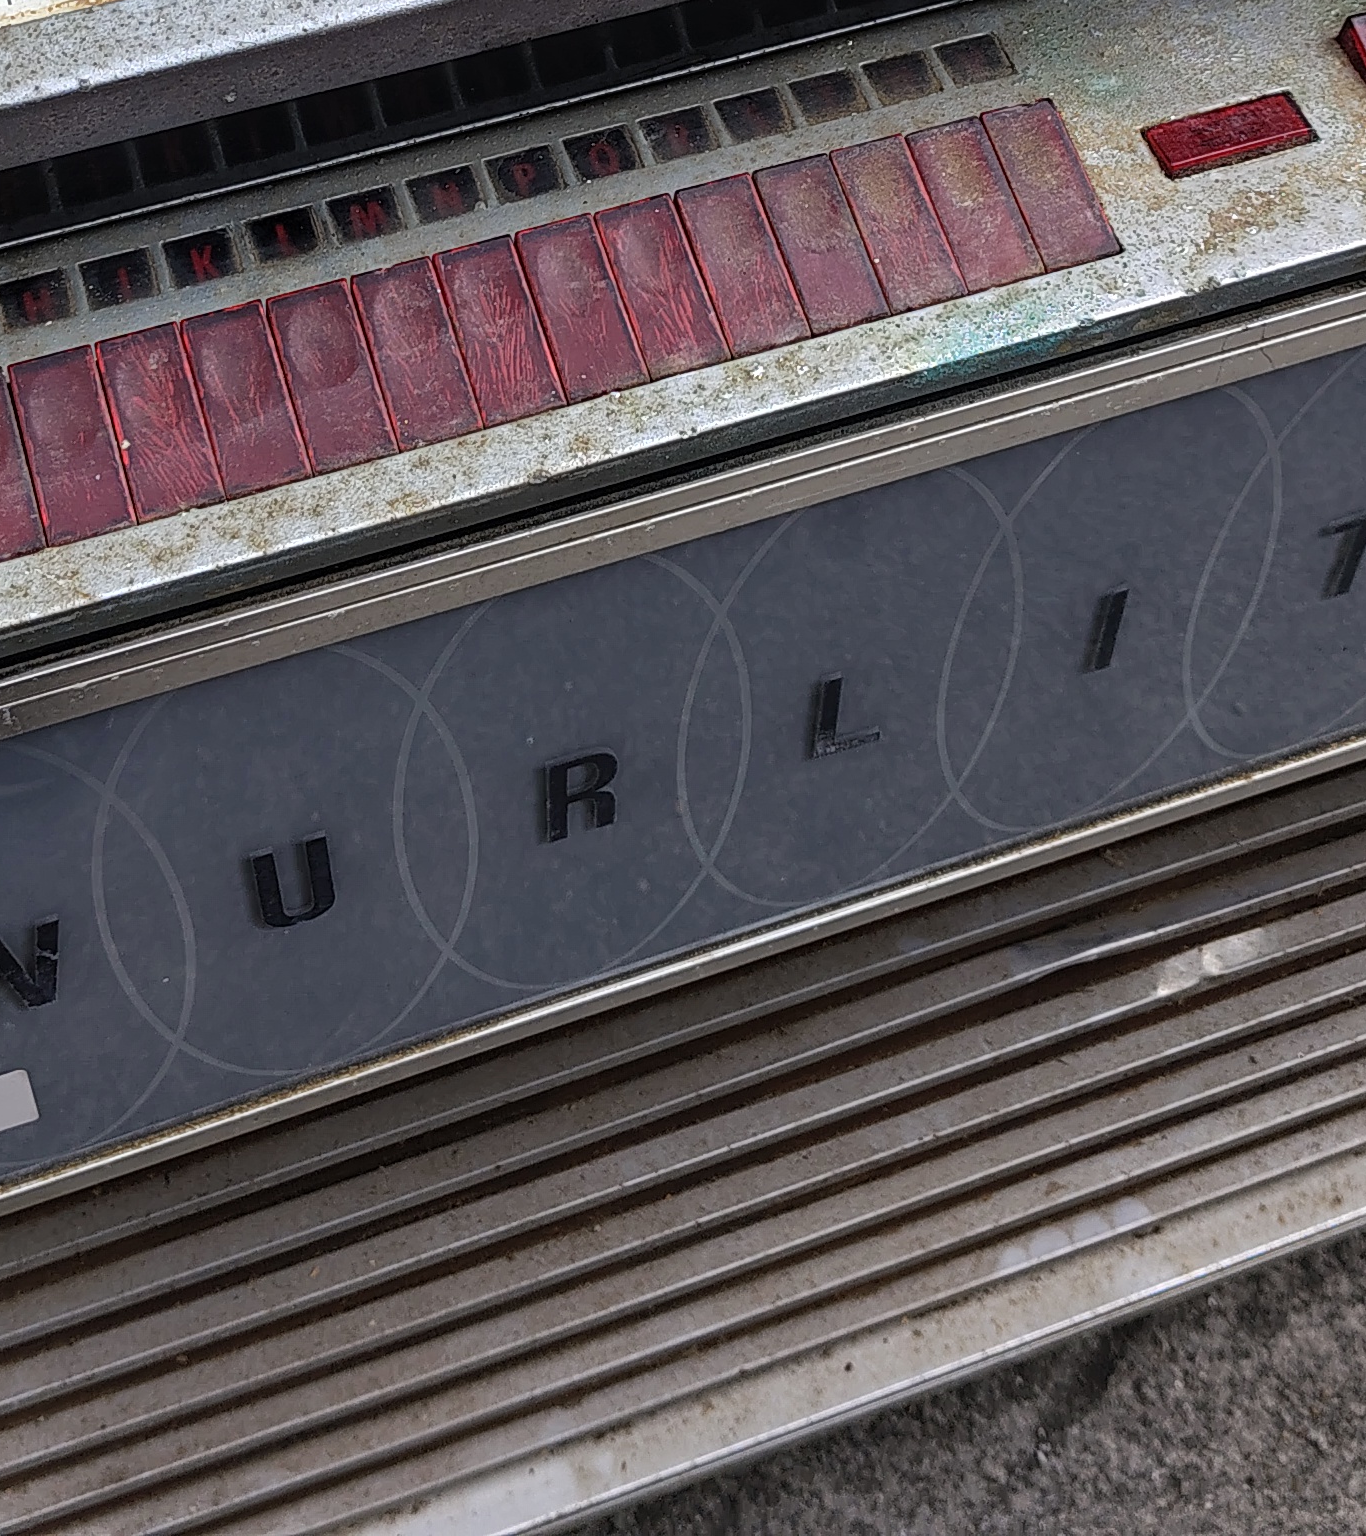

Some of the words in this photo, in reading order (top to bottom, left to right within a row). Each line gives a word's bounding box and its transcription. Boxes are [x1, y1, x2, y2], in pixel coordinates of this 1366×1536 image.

[513, 164, 536, 196] P
[349, 200, 389, 238] M
[189, 244, 219, 283] K
